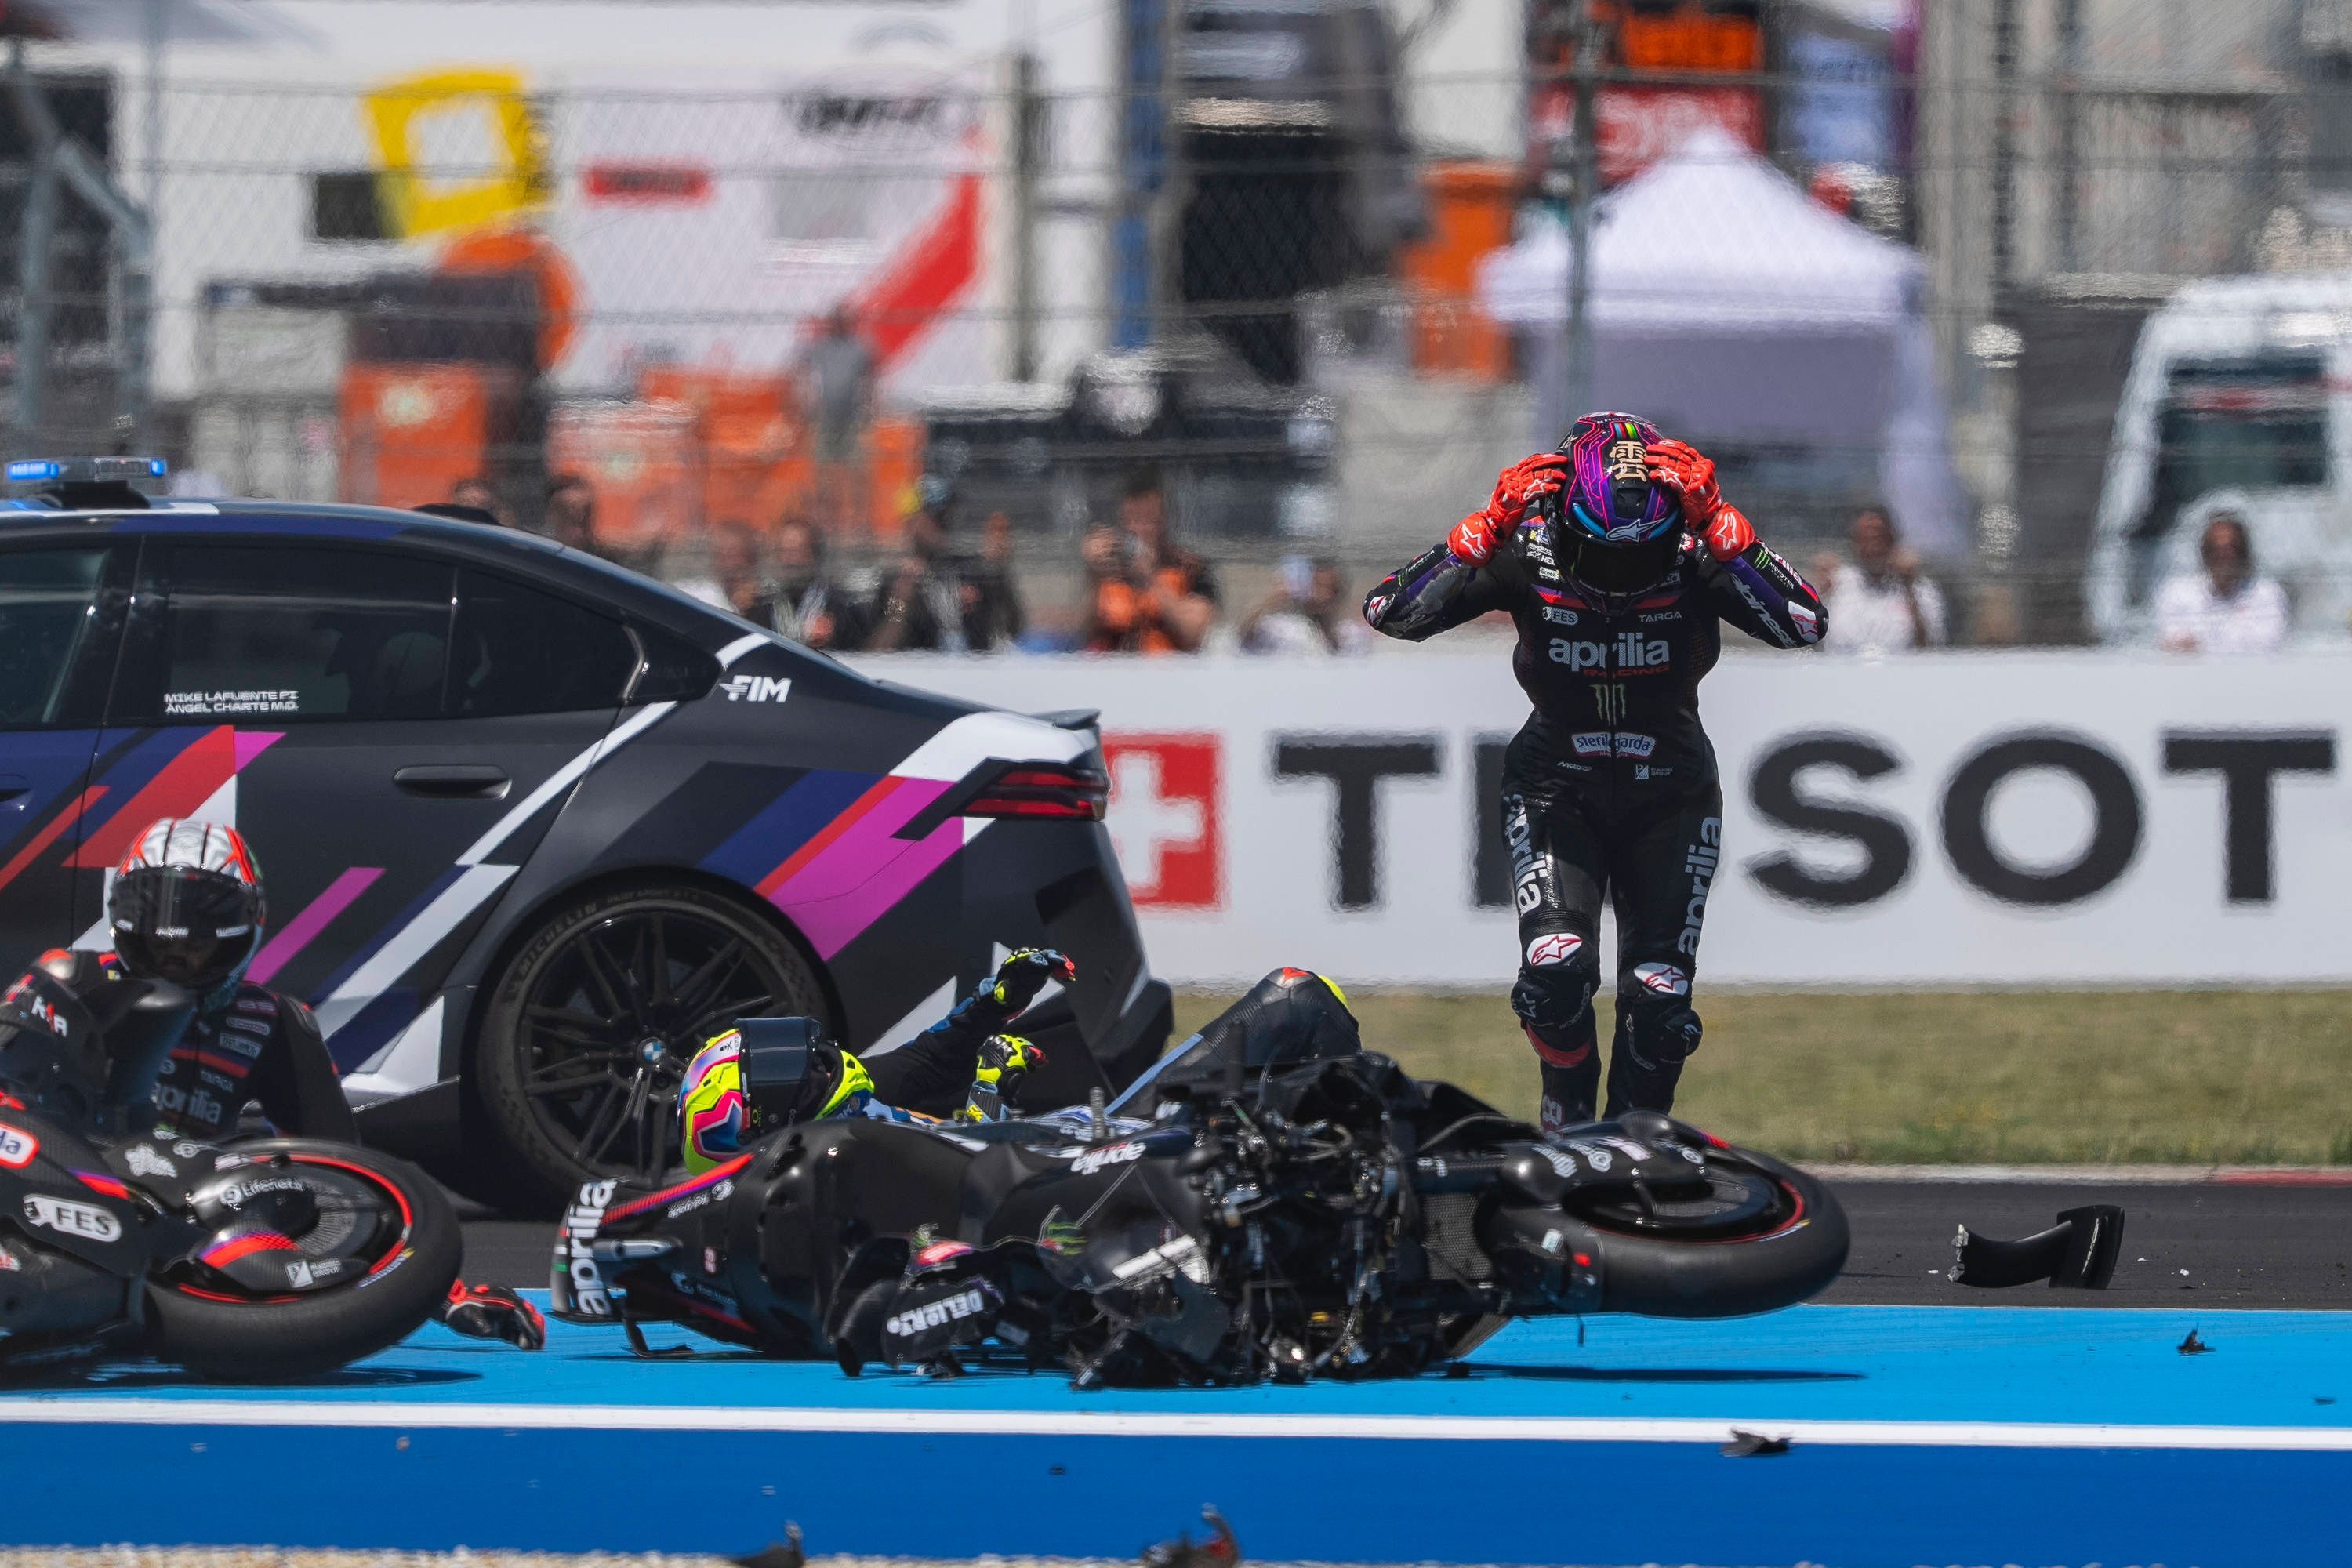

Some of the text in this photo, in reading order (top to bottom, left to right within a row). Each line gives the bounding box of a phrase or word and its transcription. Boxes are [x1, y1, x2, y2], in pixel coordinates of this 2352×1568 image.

[1769, 561, 1795, 590] MONSTER
[1555, 612, 1576, 623] FES
[1638, 611, 1682, 623] TARGA
[1548, 632, 1670, 672] aprilia
[164, 691, 203, 704] MIKE
[205, 690, 278, 702] LAFUENTE
[720, 674, 792, 702] FIM
[213, 702, 270, 713] CHARTE
[1576, 733, 1650, 750] sterilgarda
[1272, 731, 2338, 911] TISOT
[1678, 816, 1722, 956] aprilia
[519, 902, 598, 976] MICHELIN
[55, 1206, 113, 1237] FES
[568, 1178, 618, 1316] aprilia
